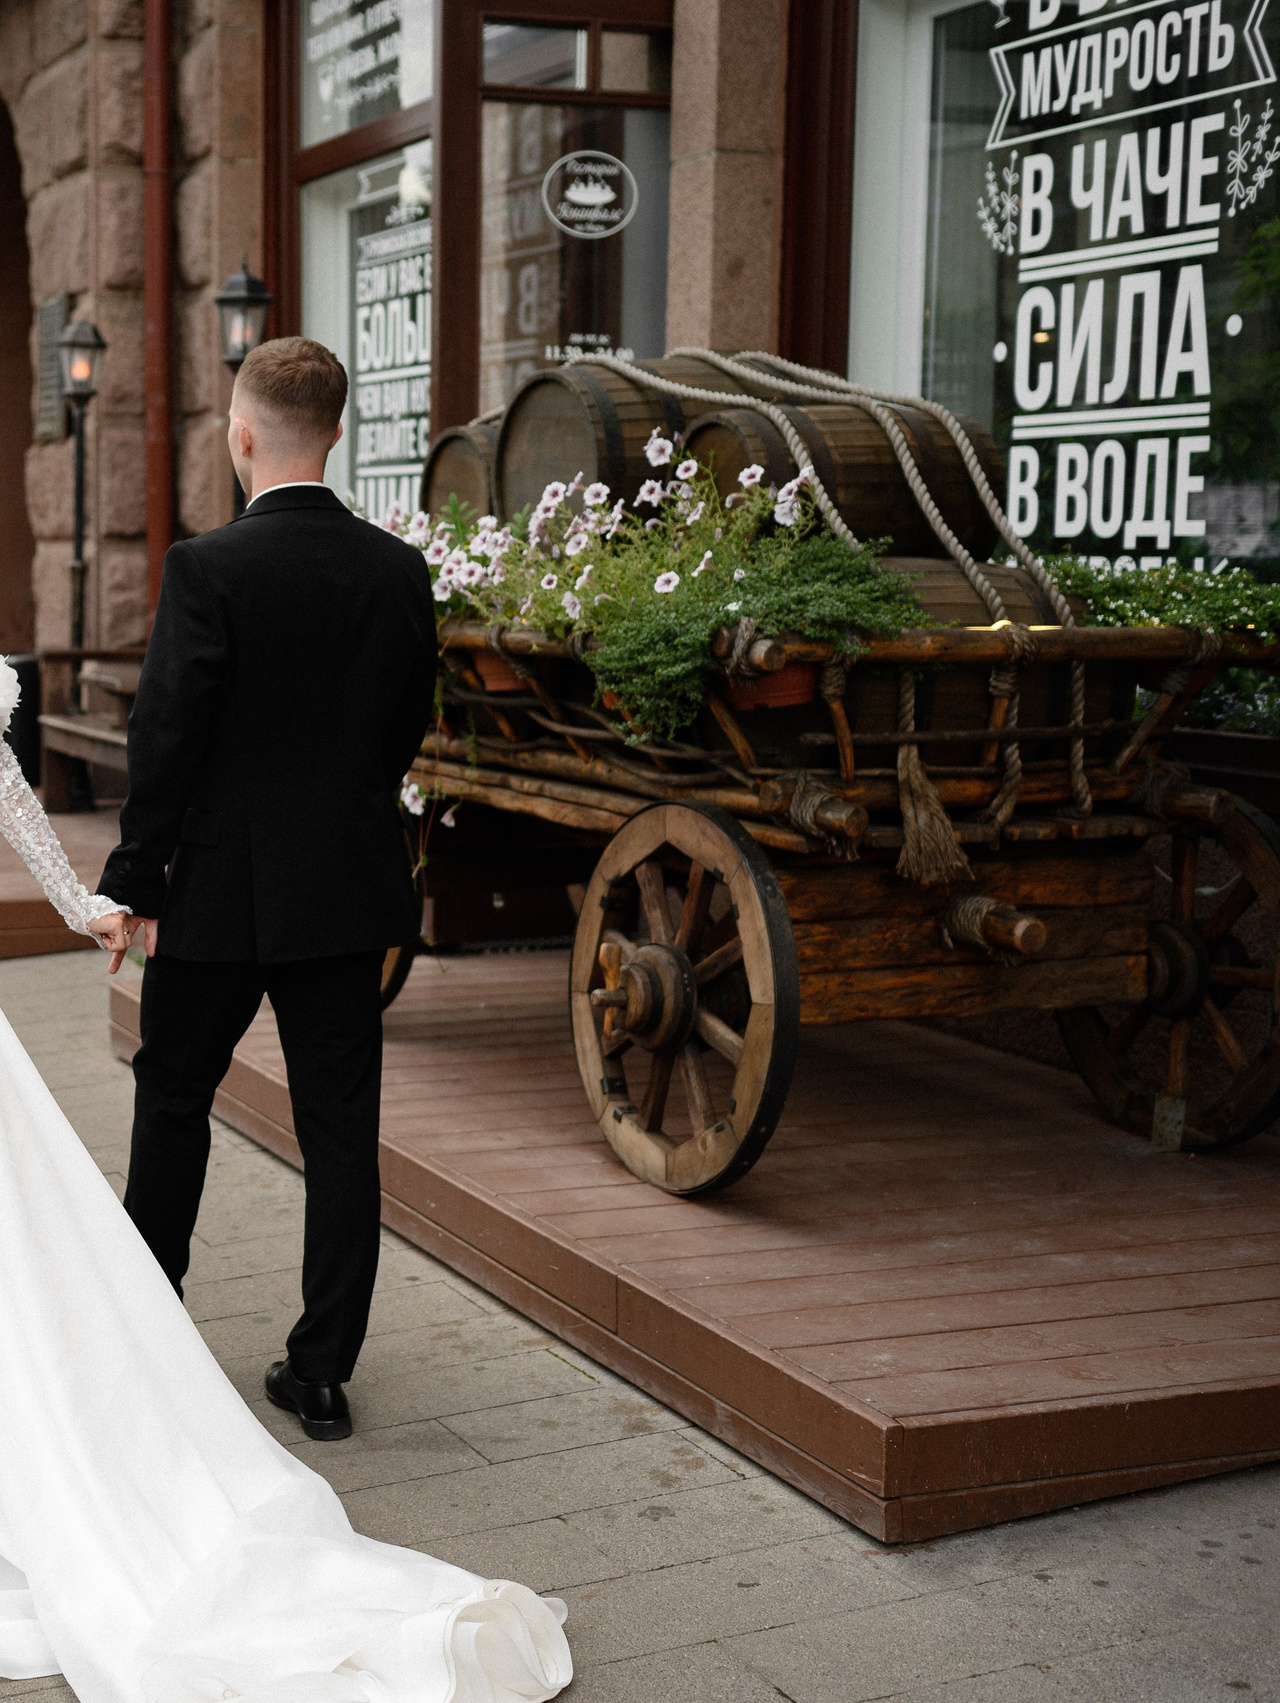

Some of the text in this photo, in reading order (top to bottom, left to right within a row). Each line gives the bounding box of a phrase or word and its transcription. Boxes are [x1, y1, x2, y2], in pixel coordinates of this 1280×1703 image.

[1020, 0, 1235, 120] МУДРОСТЬ
[1020, 112, 1225, 254] В ЧАЧЕ
[1014, 264, 1211, 411] СИЛА
[1007, 435, 1210, 550] В ВОДЕ
